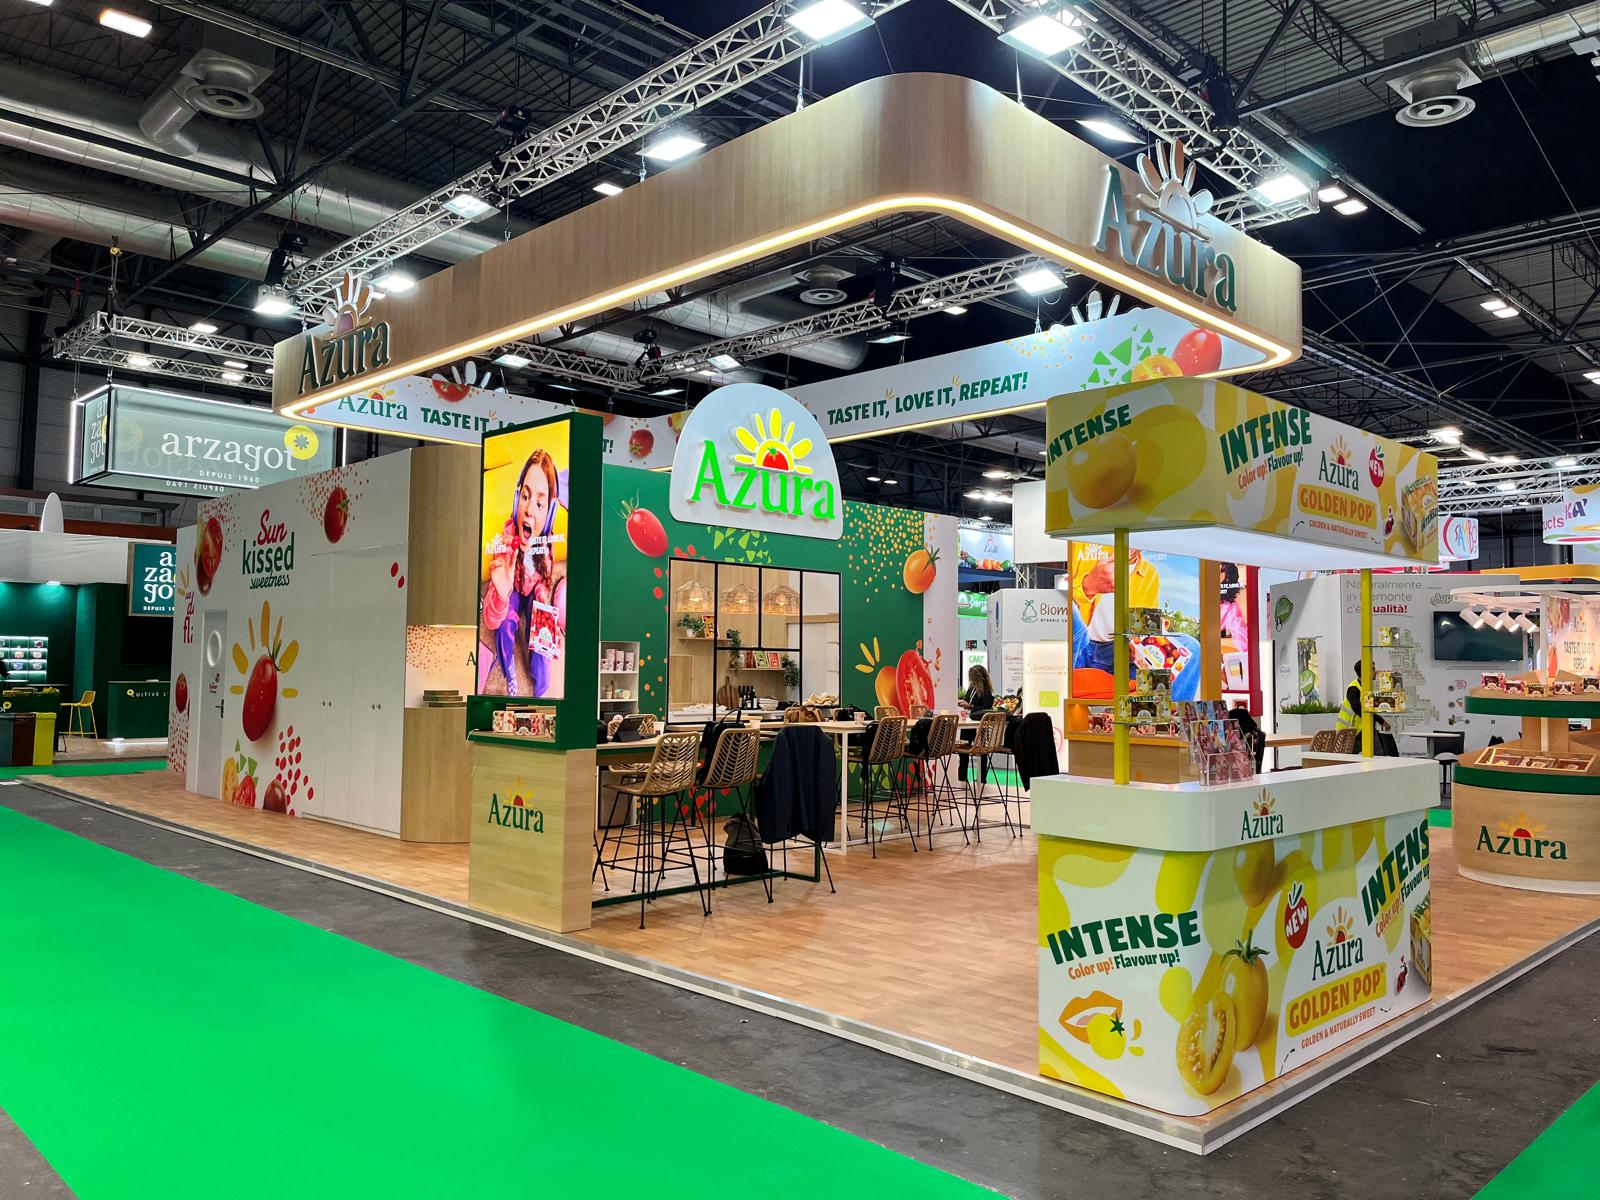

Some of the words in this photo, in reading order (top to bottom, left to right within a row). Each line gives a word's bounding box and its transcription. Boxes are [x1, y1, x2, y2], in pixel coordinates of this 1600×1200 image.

[1093, 164, 1237, 312] Azura
[298, 321, 391, 396] Azura
[337, 395, 408, 420] Azura
[420, 406, 471, 429] TASTE
[827, 403, 870, 425] TASTE
[872, 400, 890, 419] IT,
[895, 390, 934, 413] LOVE
[937, 386, 956, 407] IT,
[959, 371, 1029, 401] REPEAT!
[160, 431, 297, 472] arzagot
[1047, 404, 1132, 467] INTENSE
[1219, 407, 1312, 475] INTENSE
[199, 470, 232, 480] DEPUIS
[238, 475, 260, 484] 1960
[688, 439, 836, 520] Azura
[1237, 468, 1256, 489] Color
[1256, 459, 1268, 480] up!
[1267, 452, 1293, 473] Flavour
[1293, 446, 1304, 467] up!
[1319, 450, 1359, 491] Azura
[1368, 458, 1385, 478] NEW
[1300, 487, 1348, 519] GOLDEN
[257, 508, 288, 545] Sun
[1308, 519, 1327, 530] GOLDEN
[242, 531, 295, 575] kissed
[1077, 551, 1109, 561] Azura
[143, 567, 173, 583] za
[143, 583, 176, 603] go
[249, 569, 291, 589] sweetness
[1346, 579, 1422, 590] Naralmente
[1346, 593, 1356, 601] in
[1372, 604, 1408, 614] ualità!
[488, 793, 545, 834] Azura
[1241, 810, 1284, 841] Azura
[1476, 825, 1568, 860] Azura
[1285, 906, 1308, 938] NEW
[1375, 907, 1392, 938] Color
[1391, 892, 1401, 919] up!
[1400, 869, 1423, 903] Flavour
[1046, 910, 1201, 965] INTENSE
[1068, 963, 1095, 981] Color
[1096, 956, 1115, 976] up!
[1114, 953, 1158, 970] Flavour
[1158, 949, 1181, 967] up!
[1312, 937, 1364, 981] Azura
[1289, 981, 1350, 1030] GOLDEN
[1301, 1030, 1324, 1049] GOLDEN
[1324, 1030, 1329, 1040] &
[1329, 1015, 1359, 1036] NATURALLY
[1359, 1006, 1376, 1024] SWEET
